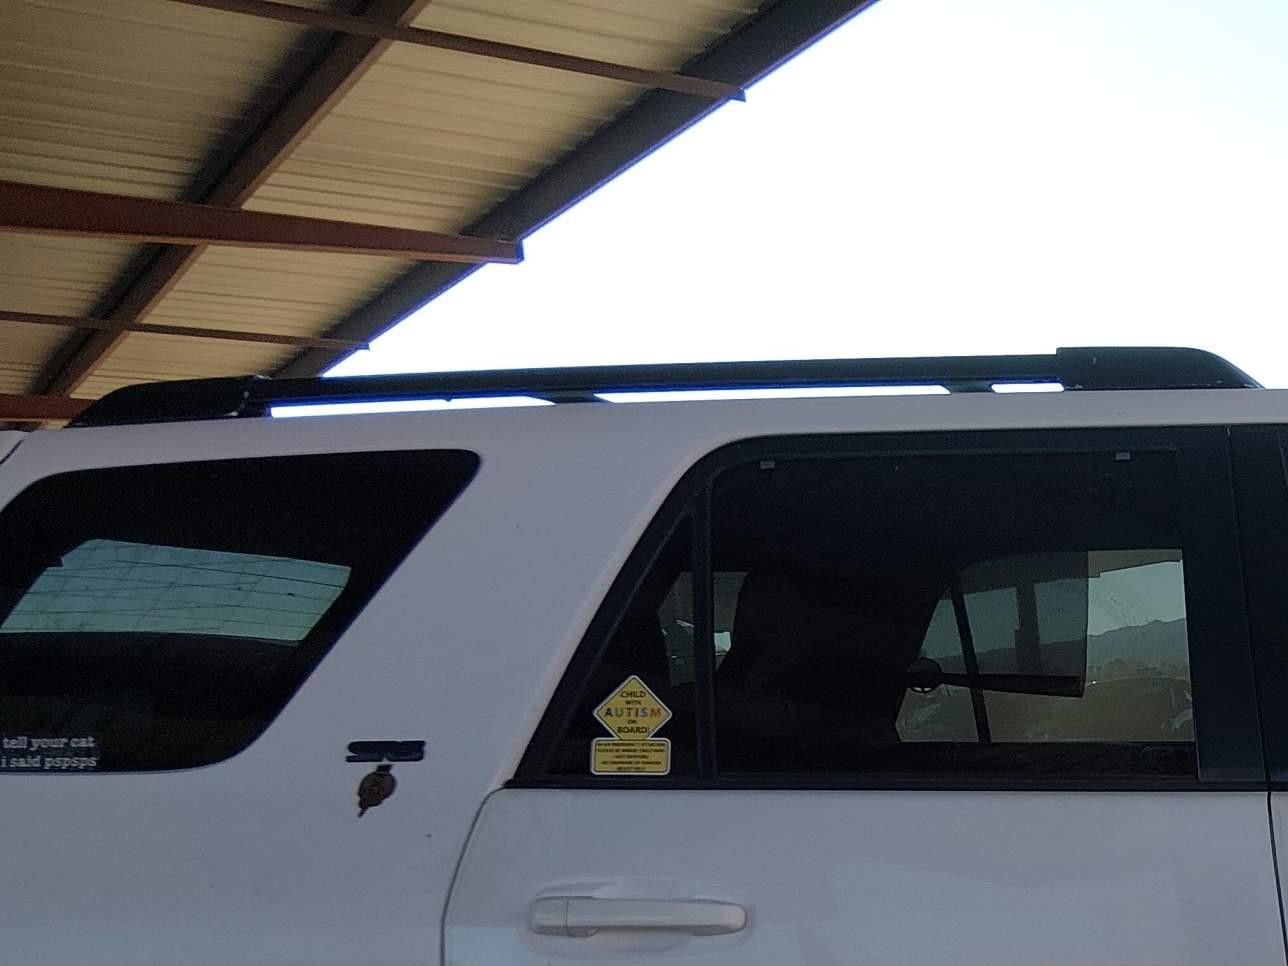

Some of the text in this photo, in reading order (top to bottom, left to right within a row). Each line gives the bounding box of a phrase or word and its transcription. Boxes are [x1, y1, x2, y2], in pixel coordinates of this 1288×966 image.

[605, 708, 662, 718] AUTISM
[617, 726, 650, 734] BOARD!
[3, 736, 96, 751] tell your cat
[10, 755, 41, 767] said
[44, 757, 97, 769] pspsps
